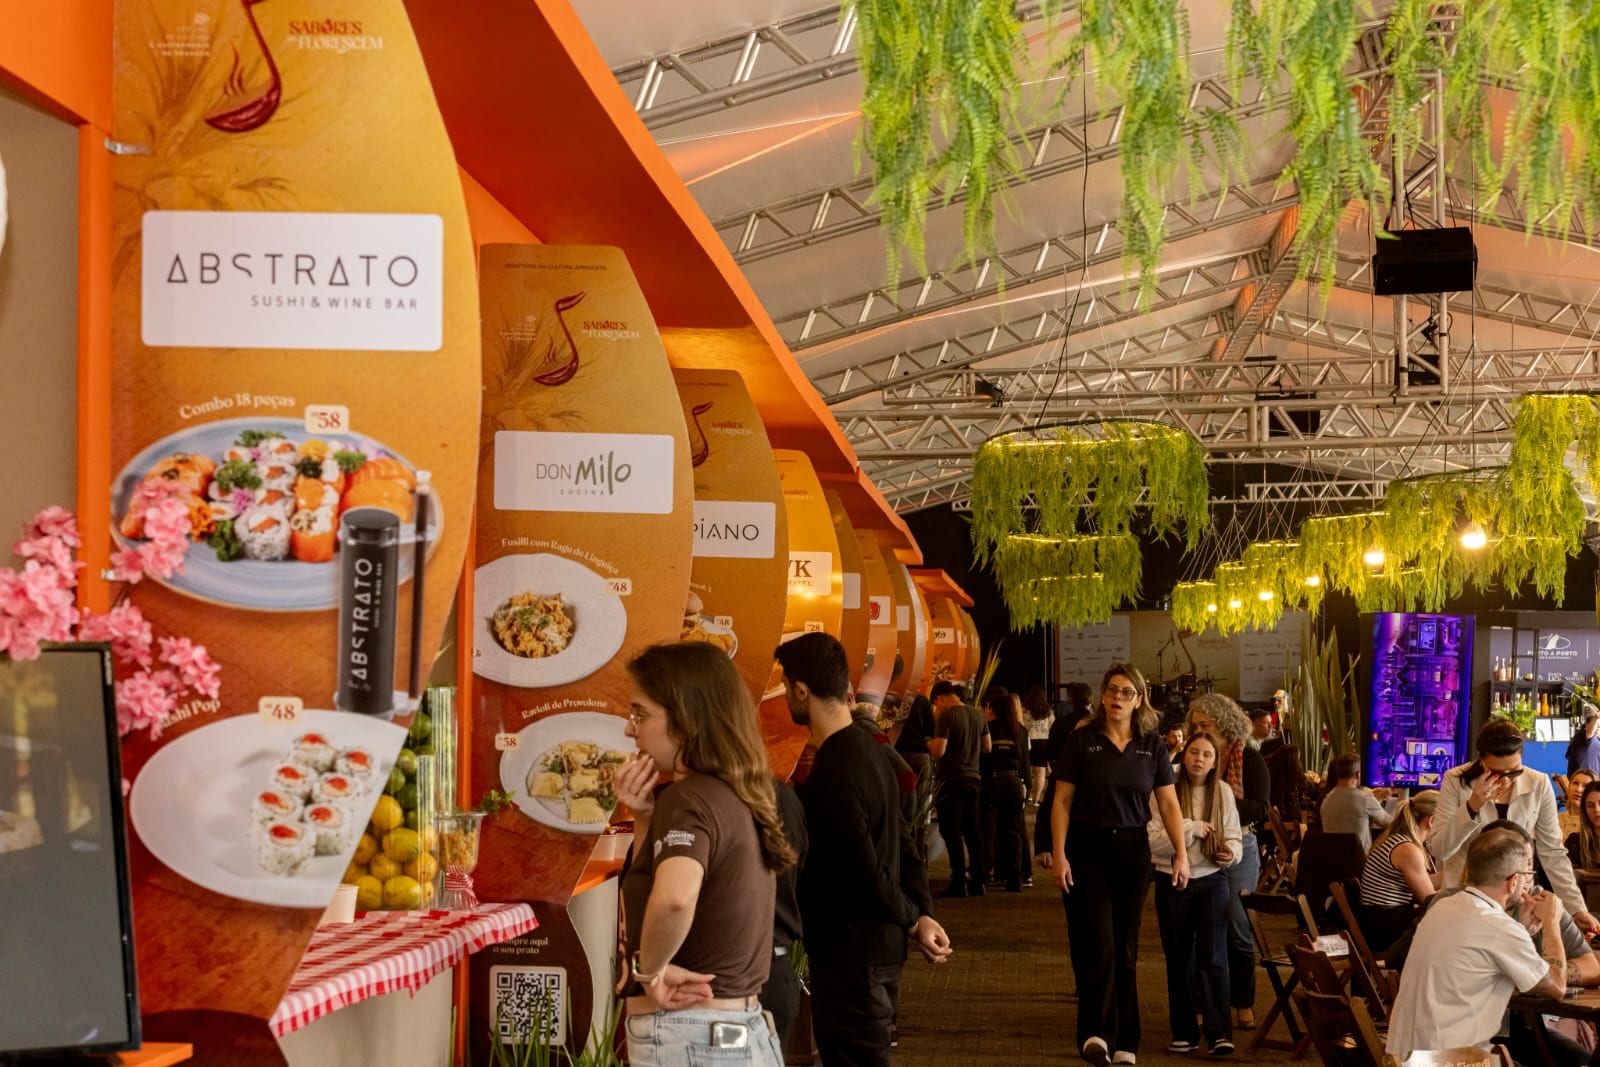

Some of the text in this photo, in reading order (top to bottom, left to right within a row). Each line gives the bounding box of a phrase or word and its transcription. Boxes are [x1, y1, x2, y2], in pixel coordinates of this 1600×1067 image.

[289, 18, 362, 35] SABORES
[167, 253, 418, 287] ABSTRATO
[328, 297, 373, 309] WINE
[384, 298, 418, 309] BAR
[583, 321, 628, 330] SABORES
[179, 393, 296, 419] Combo 18 peças
[536, 451, 632, 495] DON Milo
[502, 537, 529, 547] Fusilli
[530, 540, 549, 548] com
[551, 541, 573, 554] Ragu
[350, 558, 373, 680] ABSTRATO
[160, 700, 221, 730] ushi Pop
[521, 699, 608, 720] Ravioli de Provolone
[516, 947, 540, 955] prato
